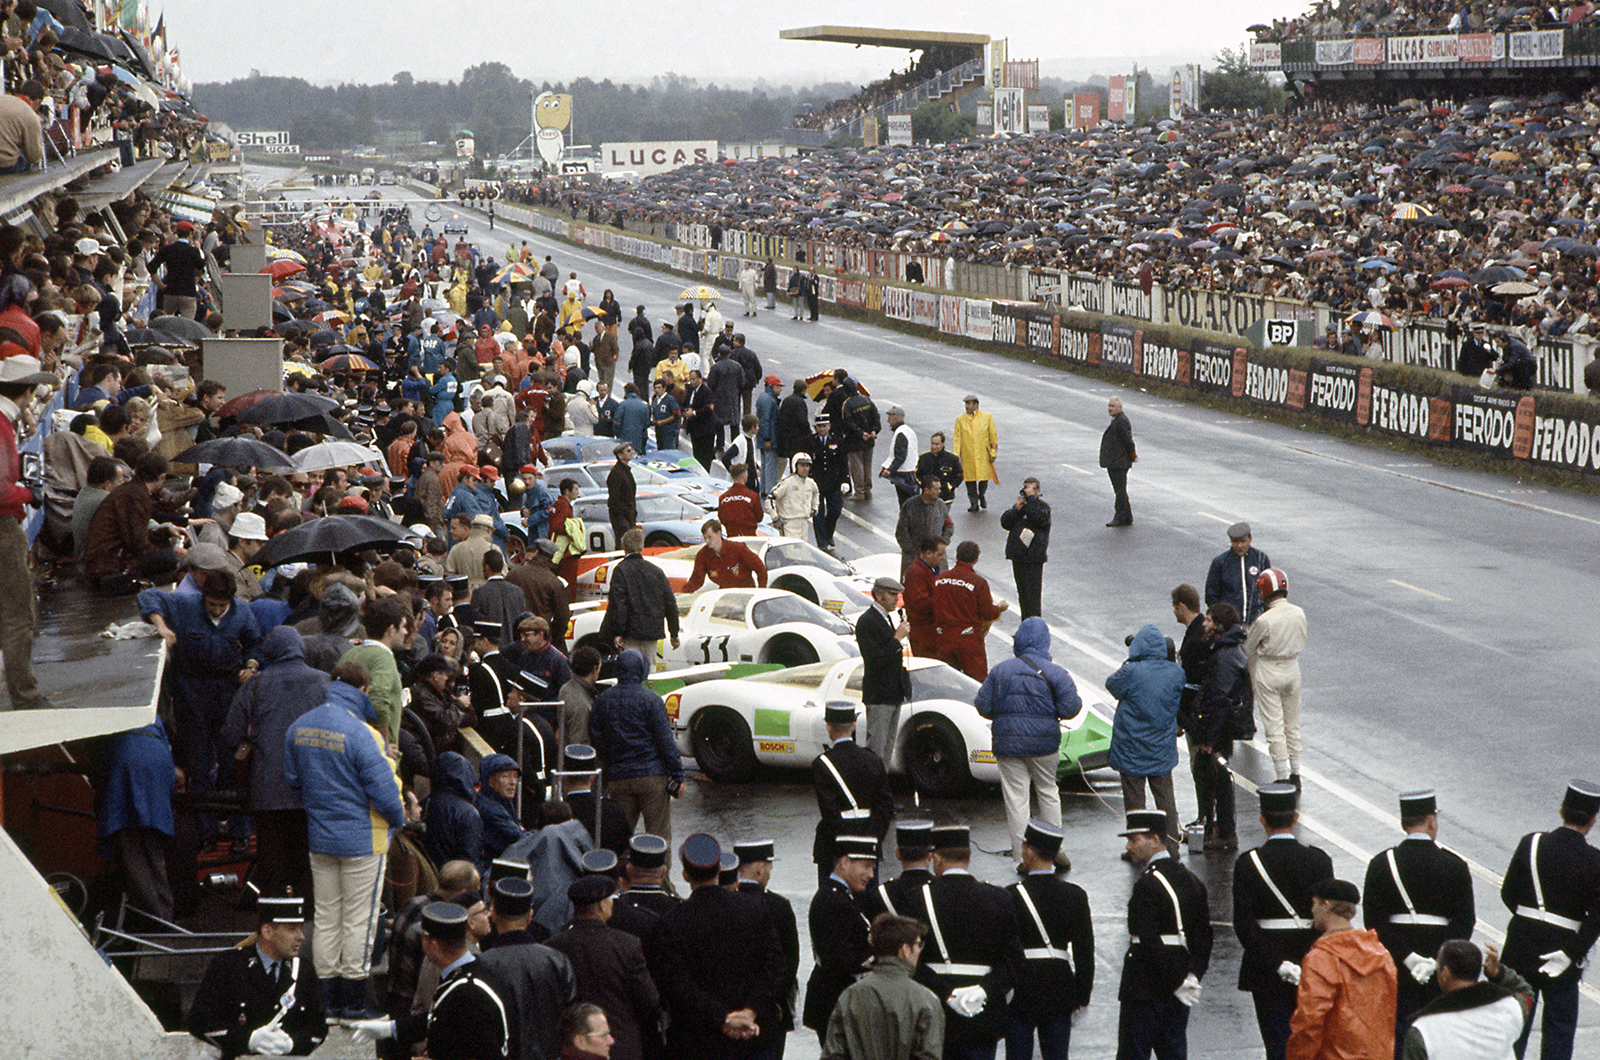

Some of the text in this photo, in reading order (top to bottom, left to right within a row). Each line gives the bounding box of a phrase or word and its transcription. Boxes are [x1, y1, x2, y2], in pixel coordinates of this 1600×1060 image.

[1390, 39, 1457, 61] LUCAS GIRLING
[1002, 92, 1015, 131] elf
[237, 132, 288, 145] Shell
[265, 146, 297, 154] LUCAS
[612, 148, 707, 165] LUCAS
[992, 314, 1016, 344] FERODO
[1029, 321, 1053, 349] FERODO
[1060, 327, 1088, 360] FERODO
[1271, 325, 1293, 343] BP
[1102, 334, 1133, 365] FERODO
[1143, 343, 1178, 380] FERODO
[1194, 352, 1231, 386] FERODO
[1246, 362, 1288, 402] FERODO
[1310, 373, 1356, 412] FERODO
[1372, 385, 1429, 437] FERODO
[1455, 404, 1515, 449] FERODO
[1532, 415, 1600, 470] FERODO
[935, 578, 975, 591] PORSCHE
[760, 743, 785, 751] BOSCH
